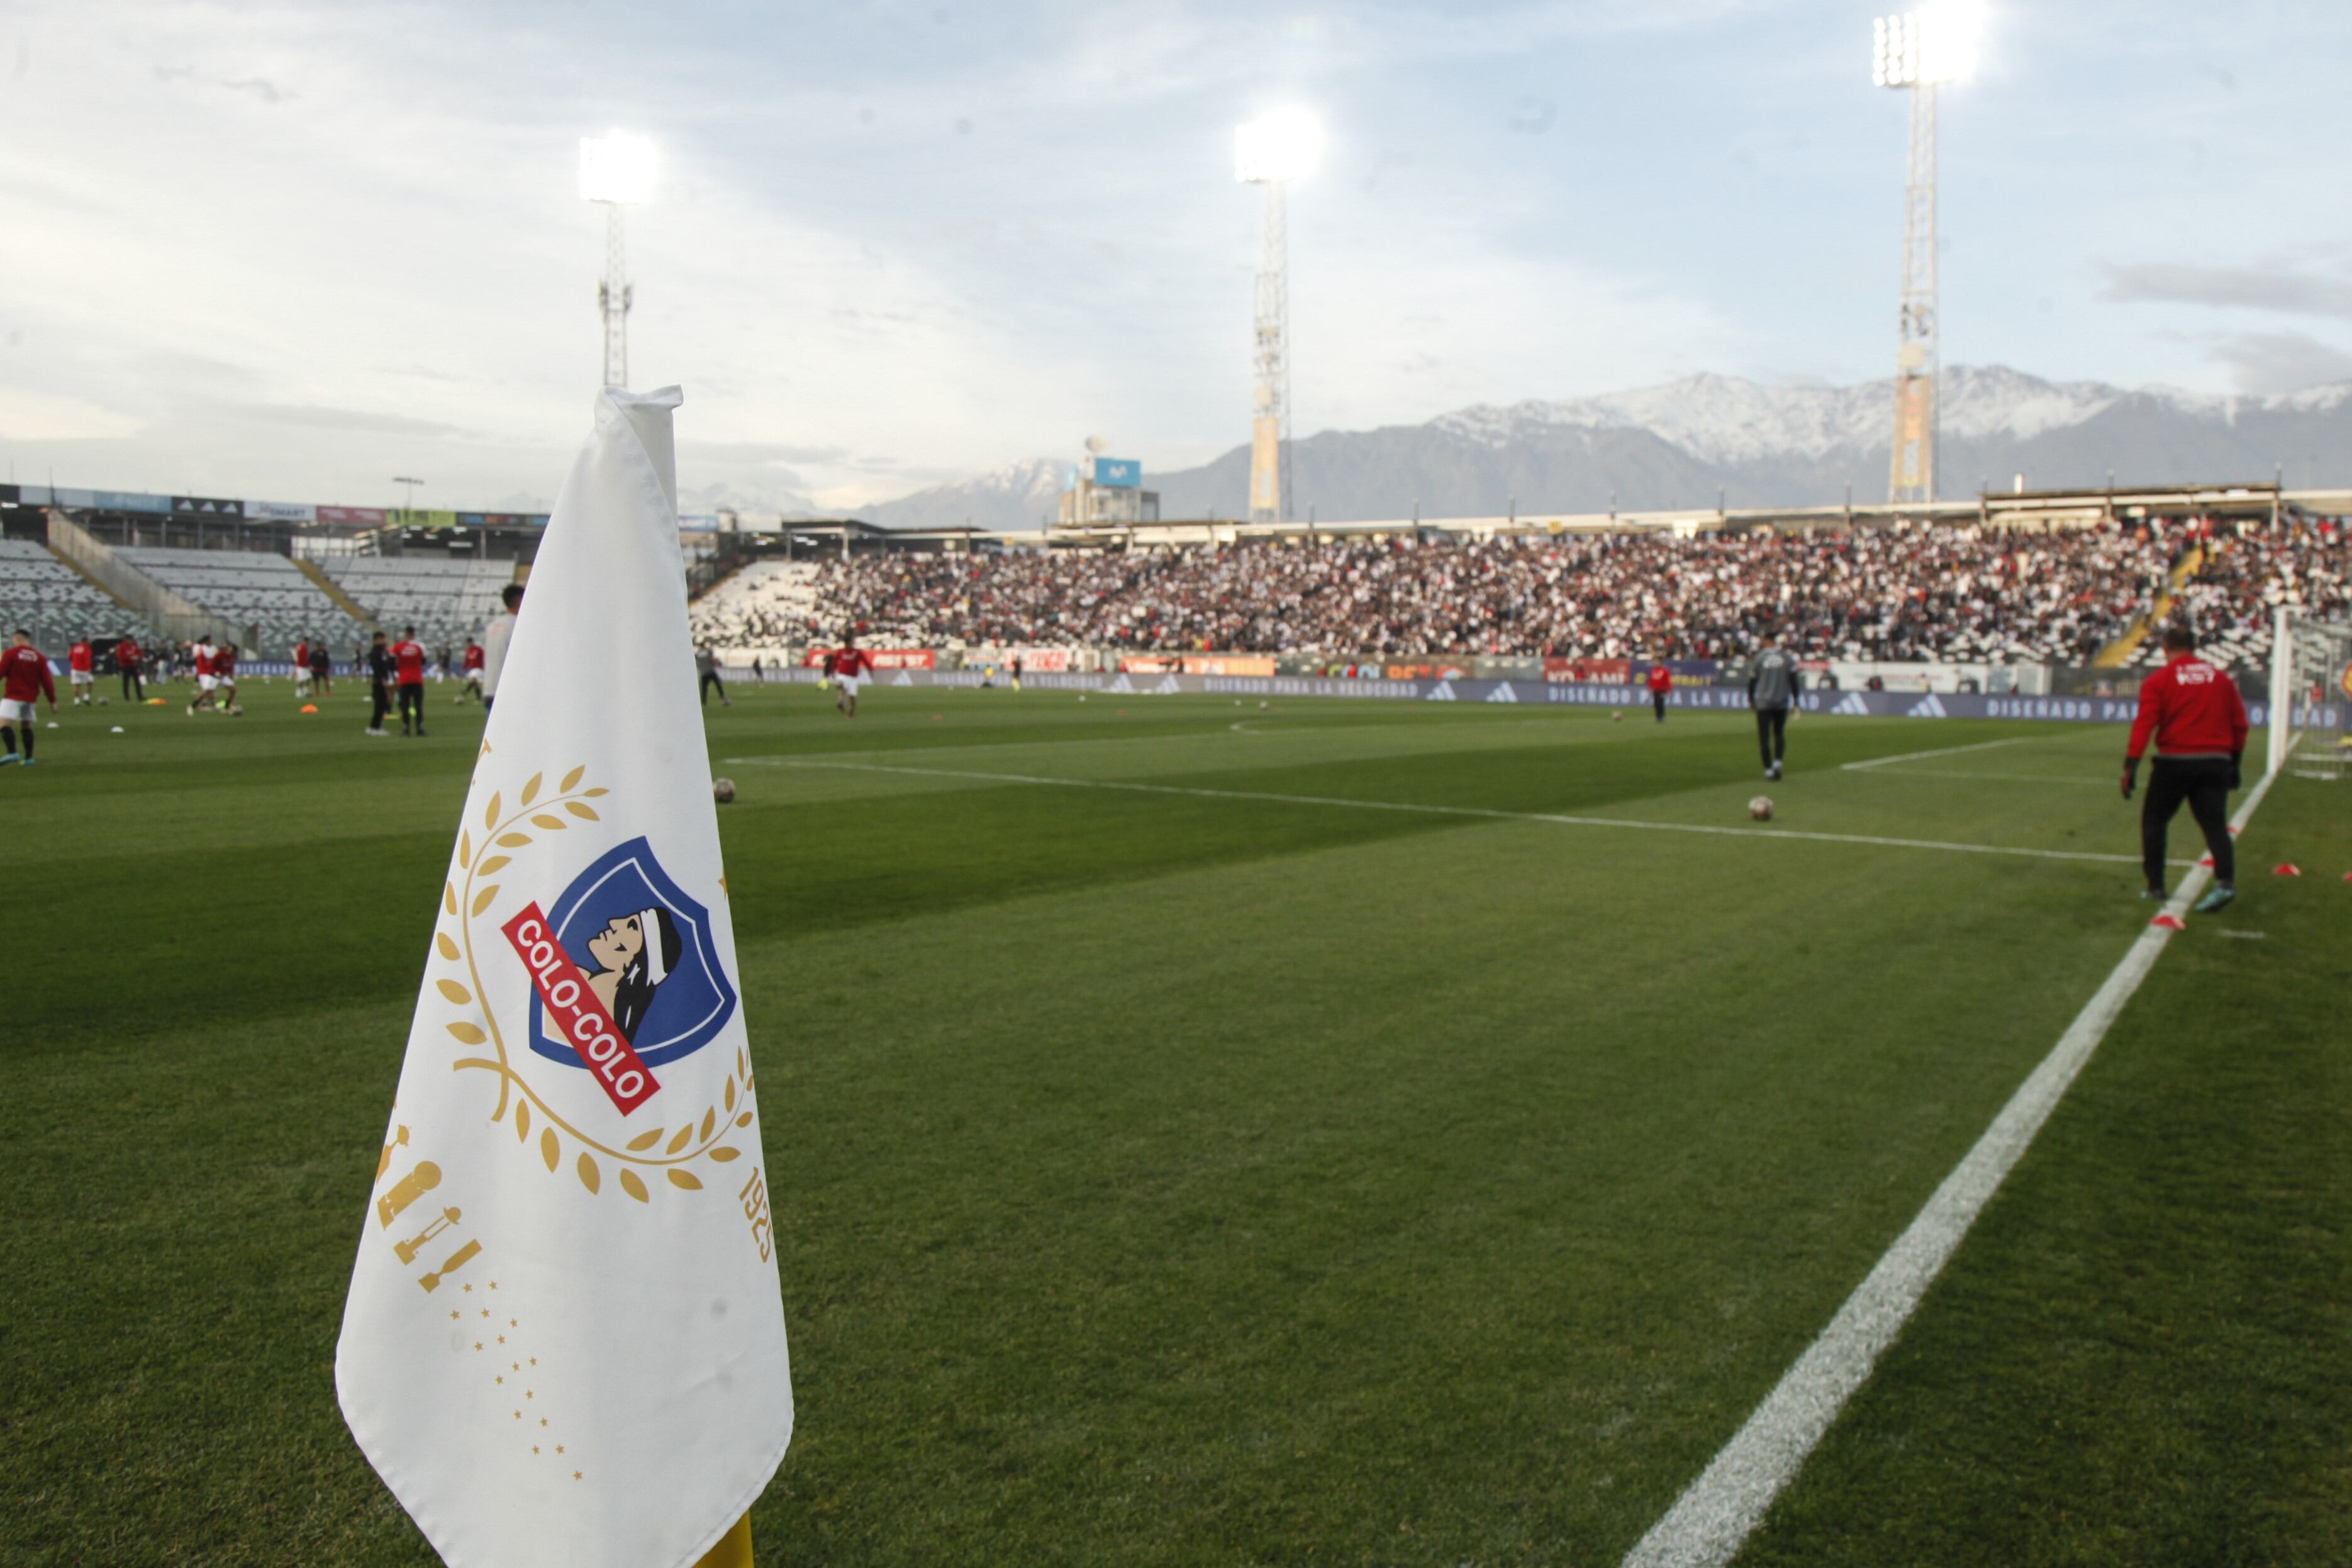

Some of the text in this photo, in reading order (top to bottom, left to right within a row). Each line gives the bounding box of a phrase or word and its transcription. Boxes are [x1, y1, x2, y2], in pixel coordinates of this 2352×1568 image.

[1547, 670, 1625, 685] KOAMI
[1986, 698, 2092, 720] DISEÑADO
[516, 919, 645, 1099] COLO-COLO
[739, 1166, 774, 1264] 1925
